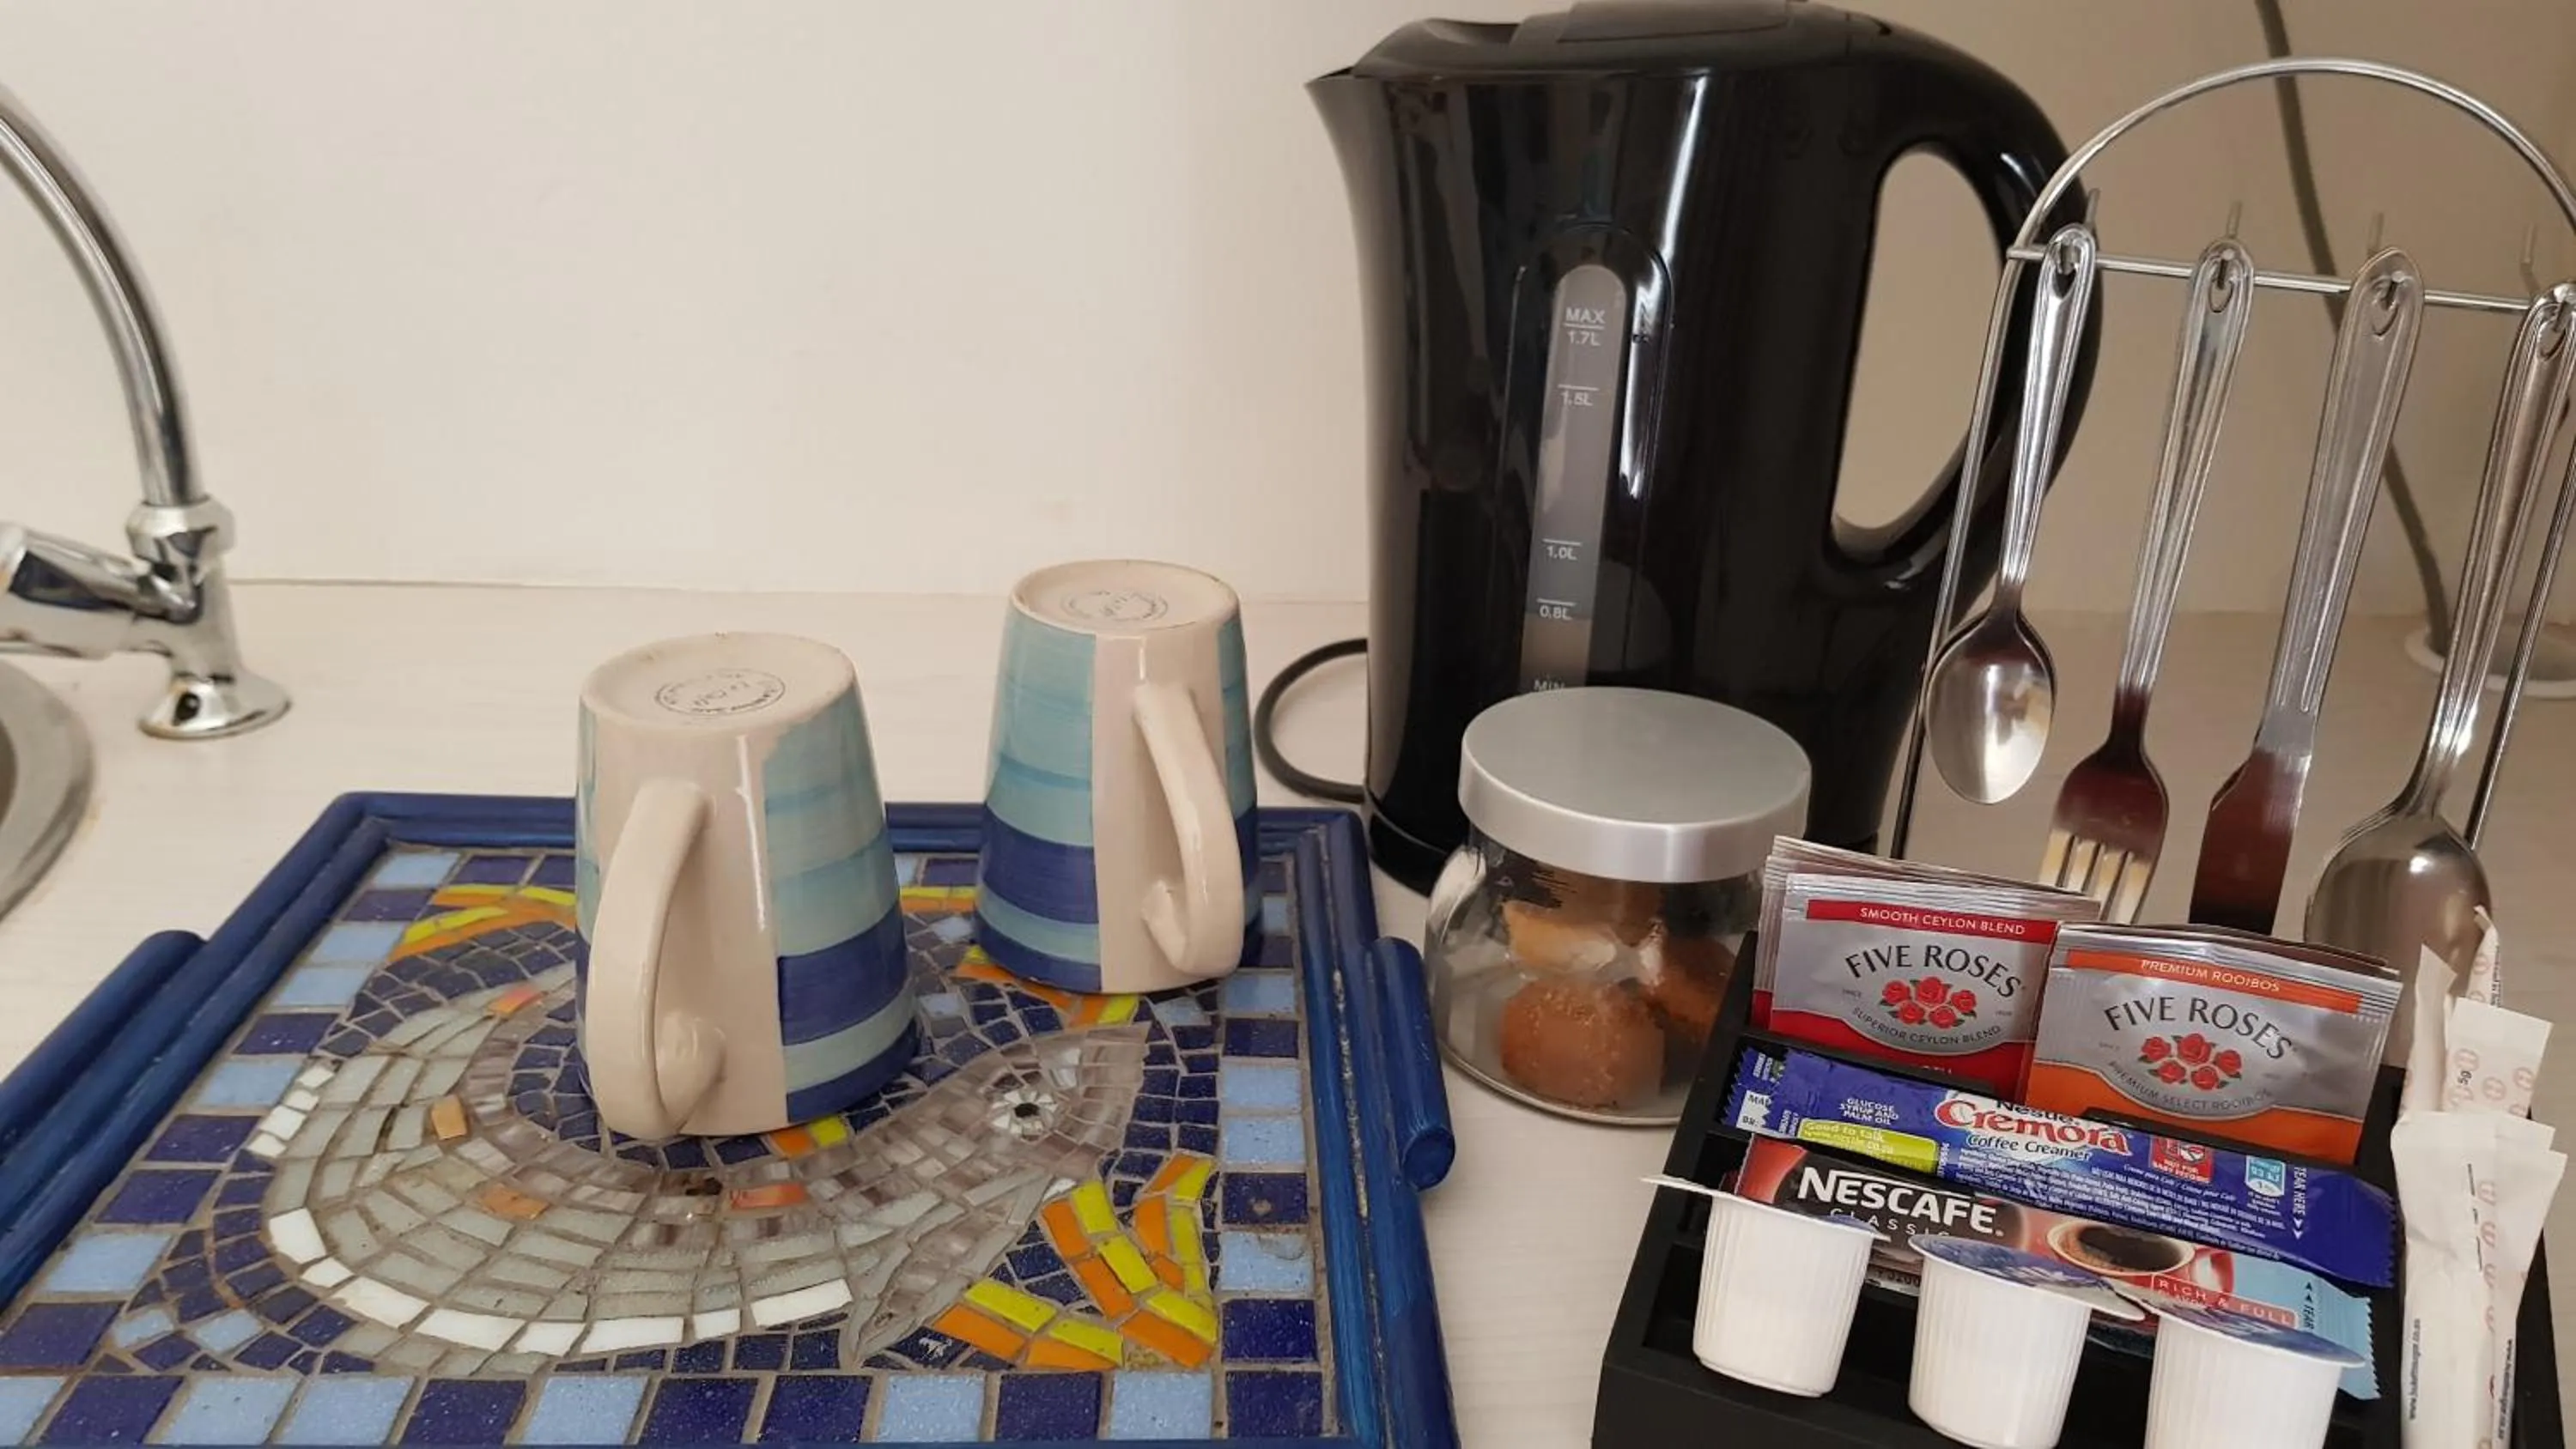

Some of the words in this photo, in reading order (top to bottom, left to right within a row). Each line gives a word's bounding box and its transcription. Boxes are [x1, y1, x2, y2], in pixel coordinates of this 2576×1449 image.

[1565, 307, 1604, 324] MAX
[1568, 331, 1600, 345] 1.7L
[1546, 545, 1577, 560] 1.0L
[1540, 605, 1572, 620] 0.8L
[1860, 907, 1918, 924] SMOOTH
[1923, 915, 1976, 929] CEYLON
[1979, 921, 2026, 935] BLEND
[1844, 945, 1912, 979] FIVE
[1923, 944, 2021, 998] ROSES
[2141, 960, 2208, 979] PREMIUM
[2212, 971, 2280, 991] ROOIBOS
[1852, 1007, 1907, 1041] SUPERIOR
[1909, 1032, 1959, 1045] CEYLON
[1962, 1025, 2002, 1043] BLEND
[2105, 997, 2175, 1031] FIVE
[2189, 997, 2293, 1059] ROSES
[2108, 1060, 2160, 1100] PREMIUM
[2162, 1094, 2207, 1111] SELECT
[2457, 1070, 2473, 1086] 5g
[1847, 1098, 1894, 1112] GLUCOSE
[1805, 1122, 1839, 1132] Good
[1843, 1125, 1856, 1136] to
[1935, 1099, 2132, 1155] Cremora
[1966, 1134, 2019, 1151] Coffee
[2025, 1143, 2092, 1160] Creamer
[2294, 1167, 2307, 1190] TEAR
[2293, 1191, 2306, 1216] HERE
[2159, 1279, 2207, 1300] RICH
[2240, 1304, 2292, 1325] FULL
